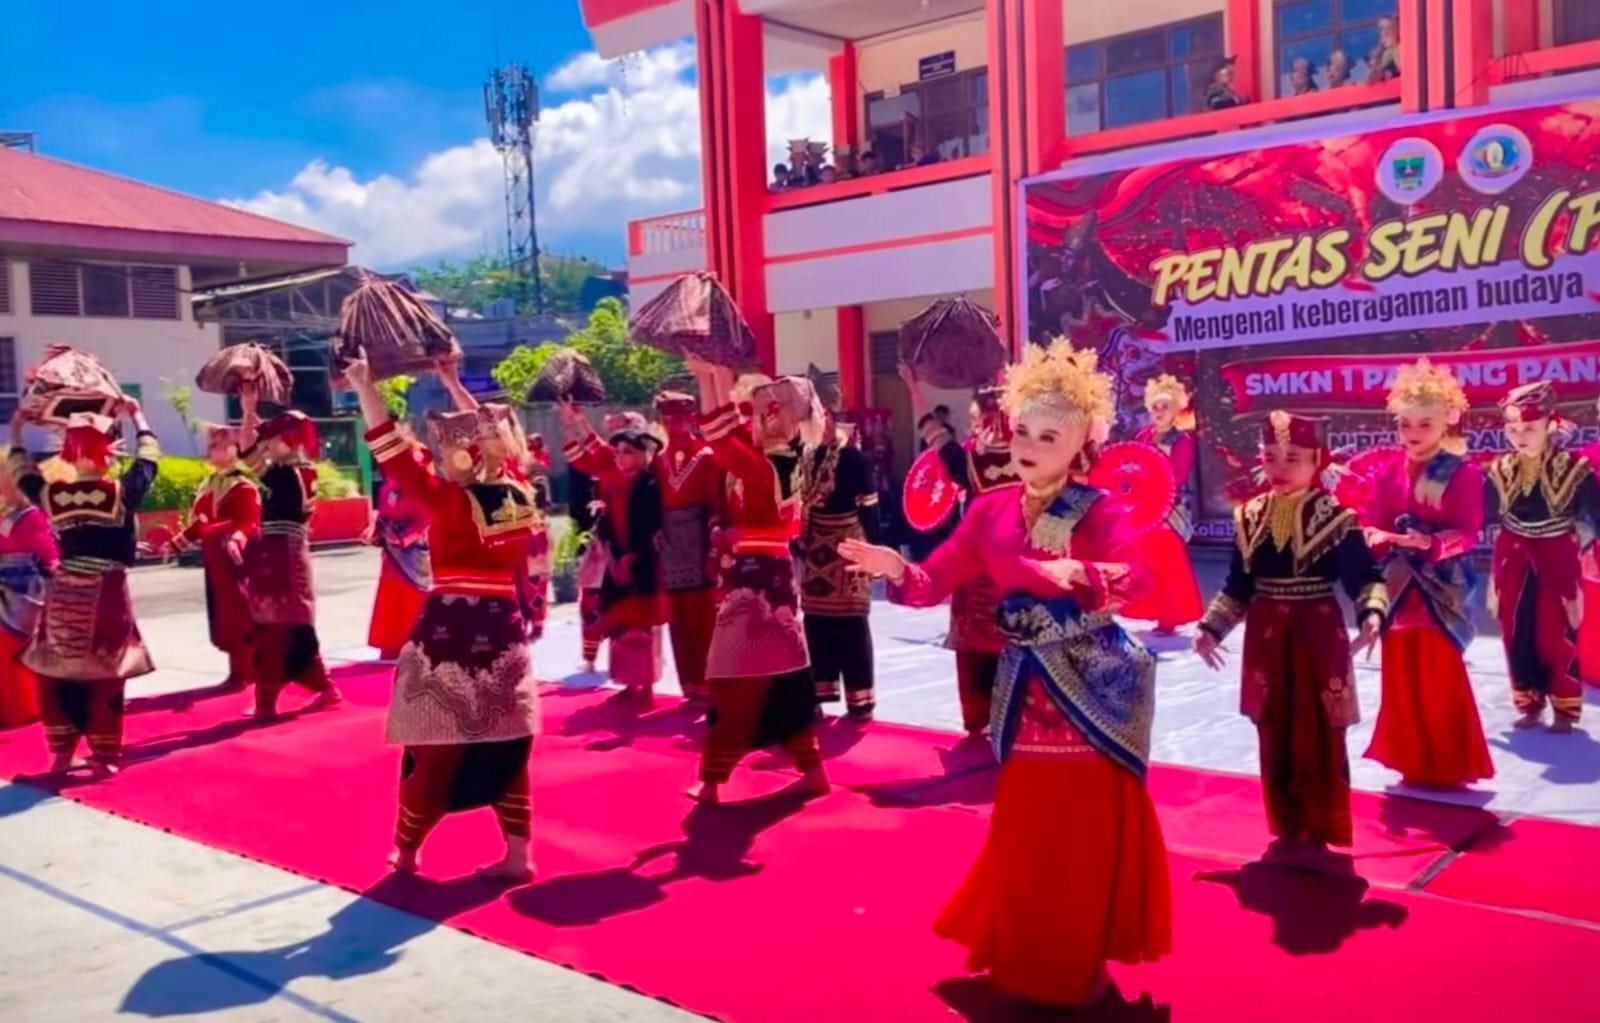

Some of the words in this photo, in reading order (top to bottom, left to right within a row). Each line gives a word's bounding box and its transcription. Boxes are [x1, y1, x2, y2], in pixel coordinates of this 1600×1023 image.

[1152, 228, 1350, 307] PENTAS
[1362, 203, 1511, 281] SENI
[1174, 305, 1285, 342] Mengenal
[1291, 284, 1469, 330] keberagaman
[1476, 270, 1584, 309] budaya
[1245, 370, 1333, 395] SMKN
[1340, 367, 1353, 392] 1
[1362, 361, 1507, 391] PANG
[1517, 355, 1600, 385] PAN
